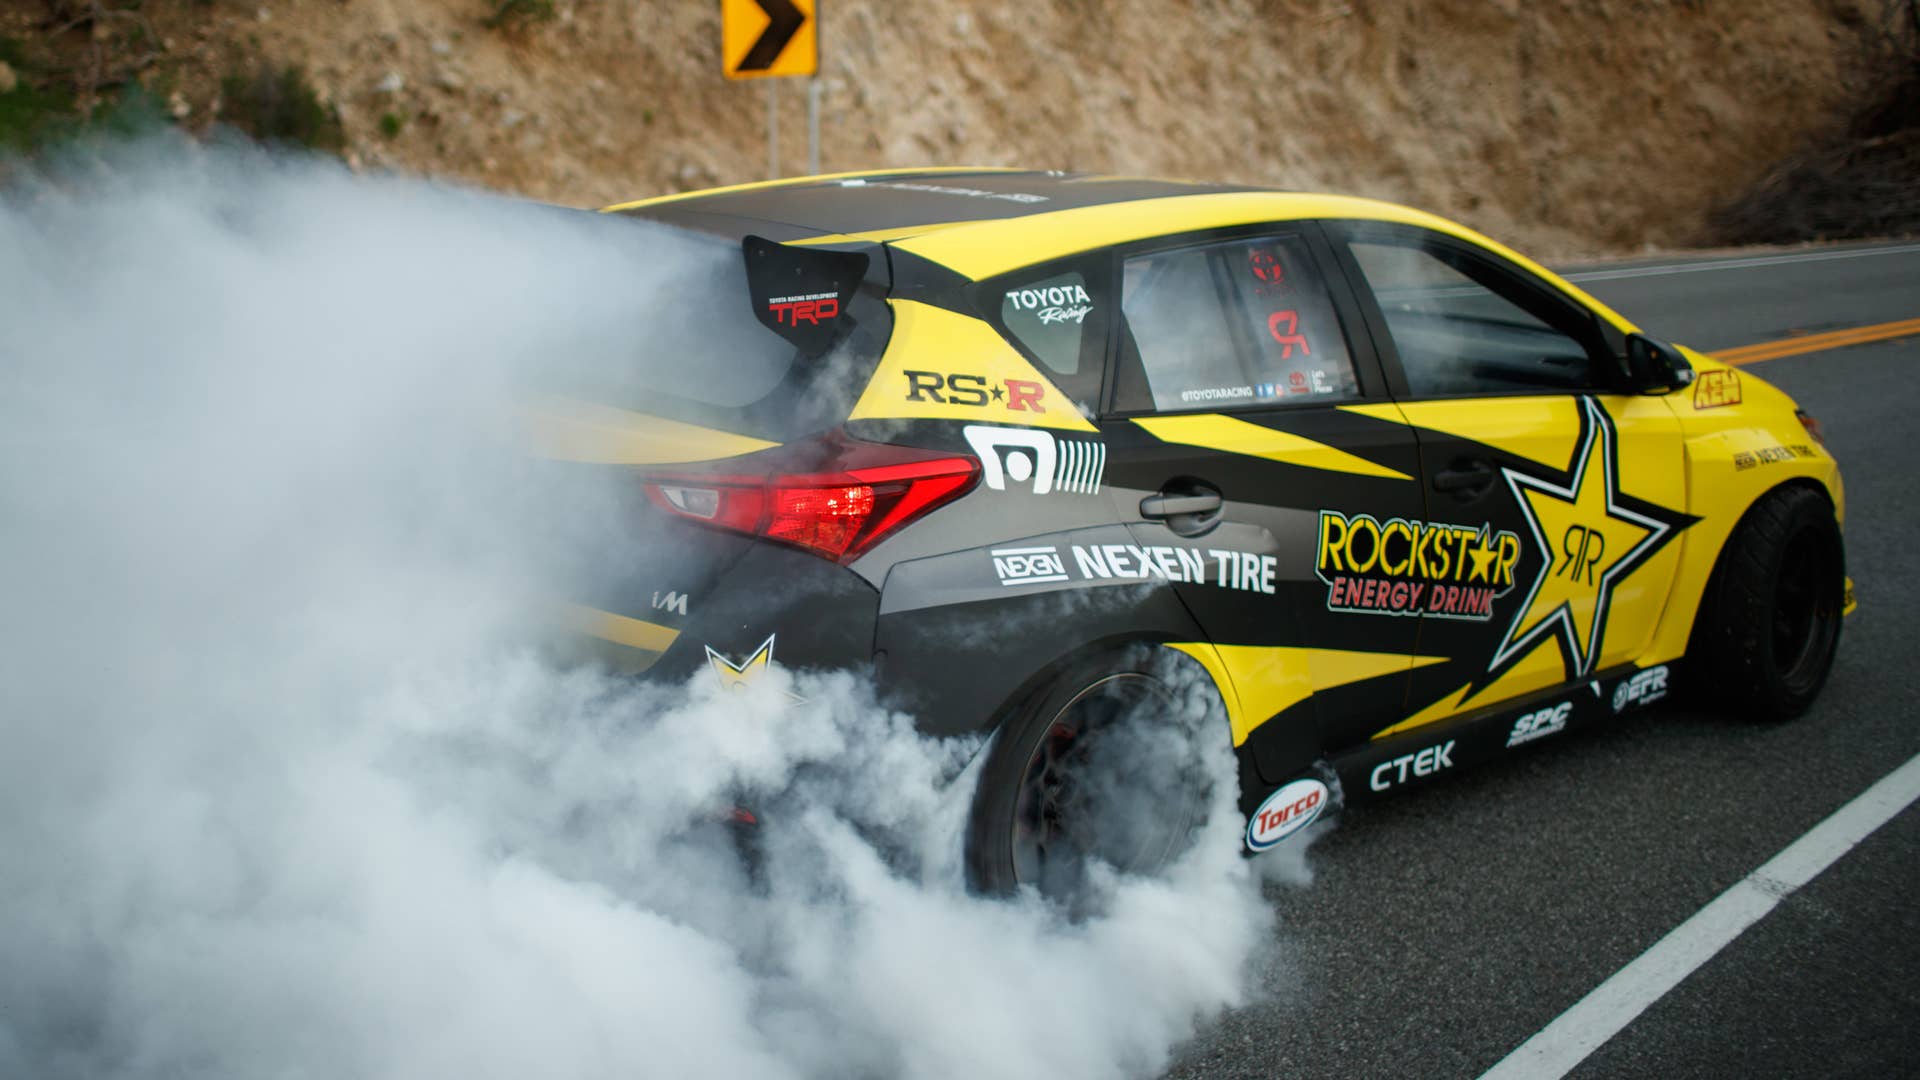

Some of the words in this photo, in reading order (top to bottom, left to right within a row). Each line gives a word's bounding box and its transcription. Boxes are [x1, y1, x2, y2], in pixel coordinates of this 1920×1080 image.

[768, 299, 839, 328] TRD
[1005, 285, 1091, 311] TOYOTA
[1037, 305, 1094, 325] Racing
[1072, 544, 1205, 584] NEXEN
[1209, 549, 1278, 595] TIRE
[1331, 577, 1425, 611] ENERGY
[1429, 584, 1497, 614] DRINK
[1510, 701, 1574, 737] SPC
[1370, 739, 1456, 792] CTEK
[1258, 789, 1320, 835] Torco
